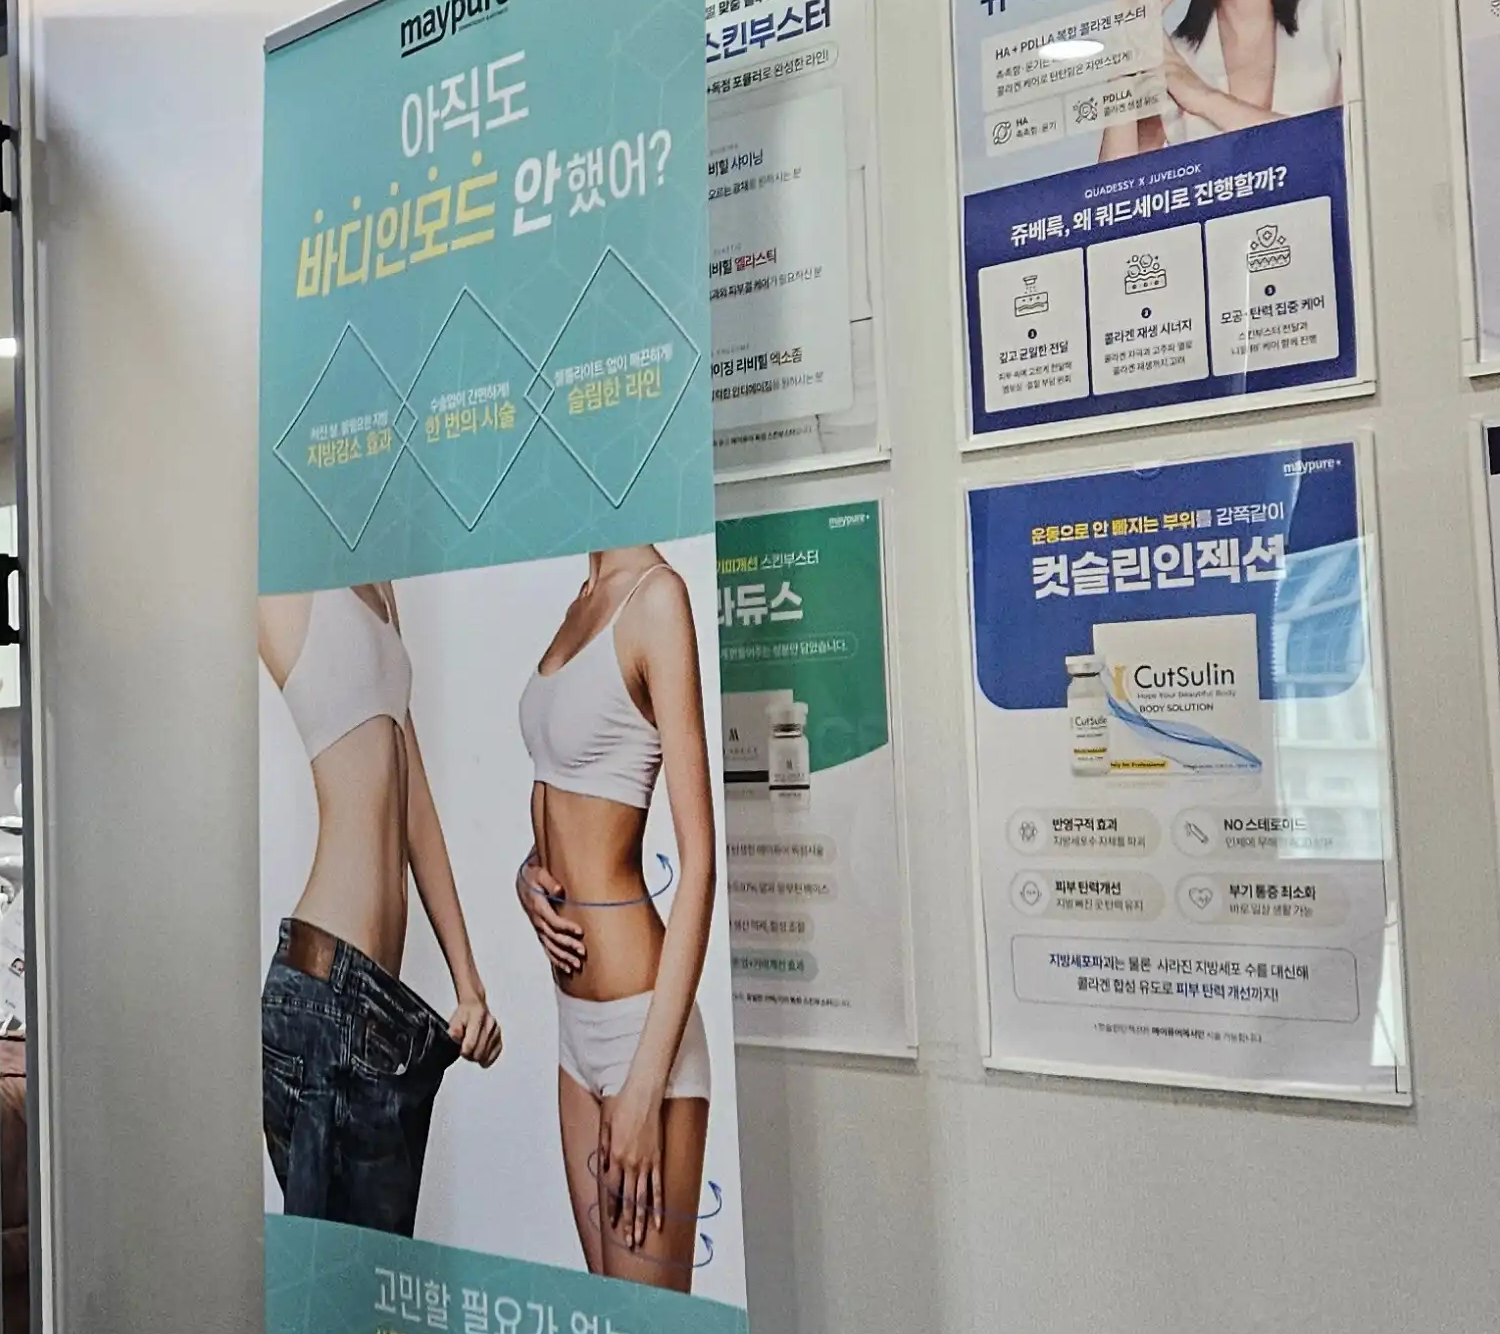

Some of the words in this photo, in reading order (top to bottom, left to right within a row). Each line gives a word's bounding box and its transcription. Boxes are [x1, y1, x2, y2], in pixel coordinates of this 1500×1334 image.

[995, 46, 1011, 61] HA
[1020, 33, 1055, 53] PDLLA
[1079, 17, 1112, 36] 콜라겐
[1114, 5, 1147, 26] 부스터
[774, 57, 804, 77] 완성한
[402, 50, 530, 158] 아직도
[1102, 89, 1133, 105] PDLLA
[1015, 116, 1029, 127] HA
[731, 148, 764, 171] 샤이닝
[1084, 178, 1135, 200] QUADESSY
[1149, 163, 1203, 185] JUVELOOK
[296, 167, 498, 299] 바디인모드
[512, 149, 562, 238] 안
[567, 128, 672, 219] 했어?
[1010, 215, 1071, 248] 쥬베룩,
[1072, 207, 1092, 234] 왜
[1095, 189, 1191, 228] 쿼드세이로
[1193, 166, 1288, 206] 진행할까?
[1274, 300, 1298, 318] 집중
[1300, 294, 1325, 313] 케어
[1104, 327, 1136, 347] 콜라겐
[1136, 323, 1159, 341] 재생
[1159, 318, 1193, 337] 시너지
[736, 352, 768, 375] 리비힐
[998, 349, 1018, 366] 깊고
[1018, 345, 1048, 363] 균일한
[1048, 340, 1070, 357] 전달
[567, 374, 621, 417] 슬림한
[625, 364, 662, 402] 라인
[424, 413, 441, 444] 한
[444, 406, 478, 441] 번의
[480, 399, 517, 433] 시술
[306, 433, 363, 469] 지방감소
[365, 426, 393, 458] 효과
[1031, 524, 1090, 546] 운동으로
[1091, 520, 1109, 540] 안
[1111, 514, 1159, 538] 빠지는
[1161, 508, 1213, 531] 부위를
[1215, 502, 1285, 528] 감쪽같이
[759, 549, 819, 570] 스킨부스터
[1031, 533, 1287, 600] 컷슬린인젝션
[1134, 662, 1235, 689] CutSulin
[1139, 704, 1166, 713] BODY
[1166, 702, 1214, 712] SOLUTION
[1052, 817, 1095, 833] 반영구적
[1096, 817, 1118, 833] 효과
[1224, 818, 1244, 831] NO
[1245, 817, 1308, 833] 스테로이드
[1054, 880, 1077, 895] 피부
[1229, 883, 1253, 899] 부기
[1280, 884, 1317, 901] 최소화
[1049, 952, 1125, 972] 지방세포파괴는
[1156, 958, 1193, 976] 사라진
[1195, 960, 1242, 978] 지방세포
[1243, 962, 1268, 979] 수를
[1270, 964, 1310, 981] 대신해
[1077, 976, 1111, 994] 콜라겐
[1139, 979, 1174, 997] 유도로
[1175, 982, 1200, 999] 피부
[1201, 982, 1226, 1000] 탄력
[374, 1266, 452, 1331] 고민할
